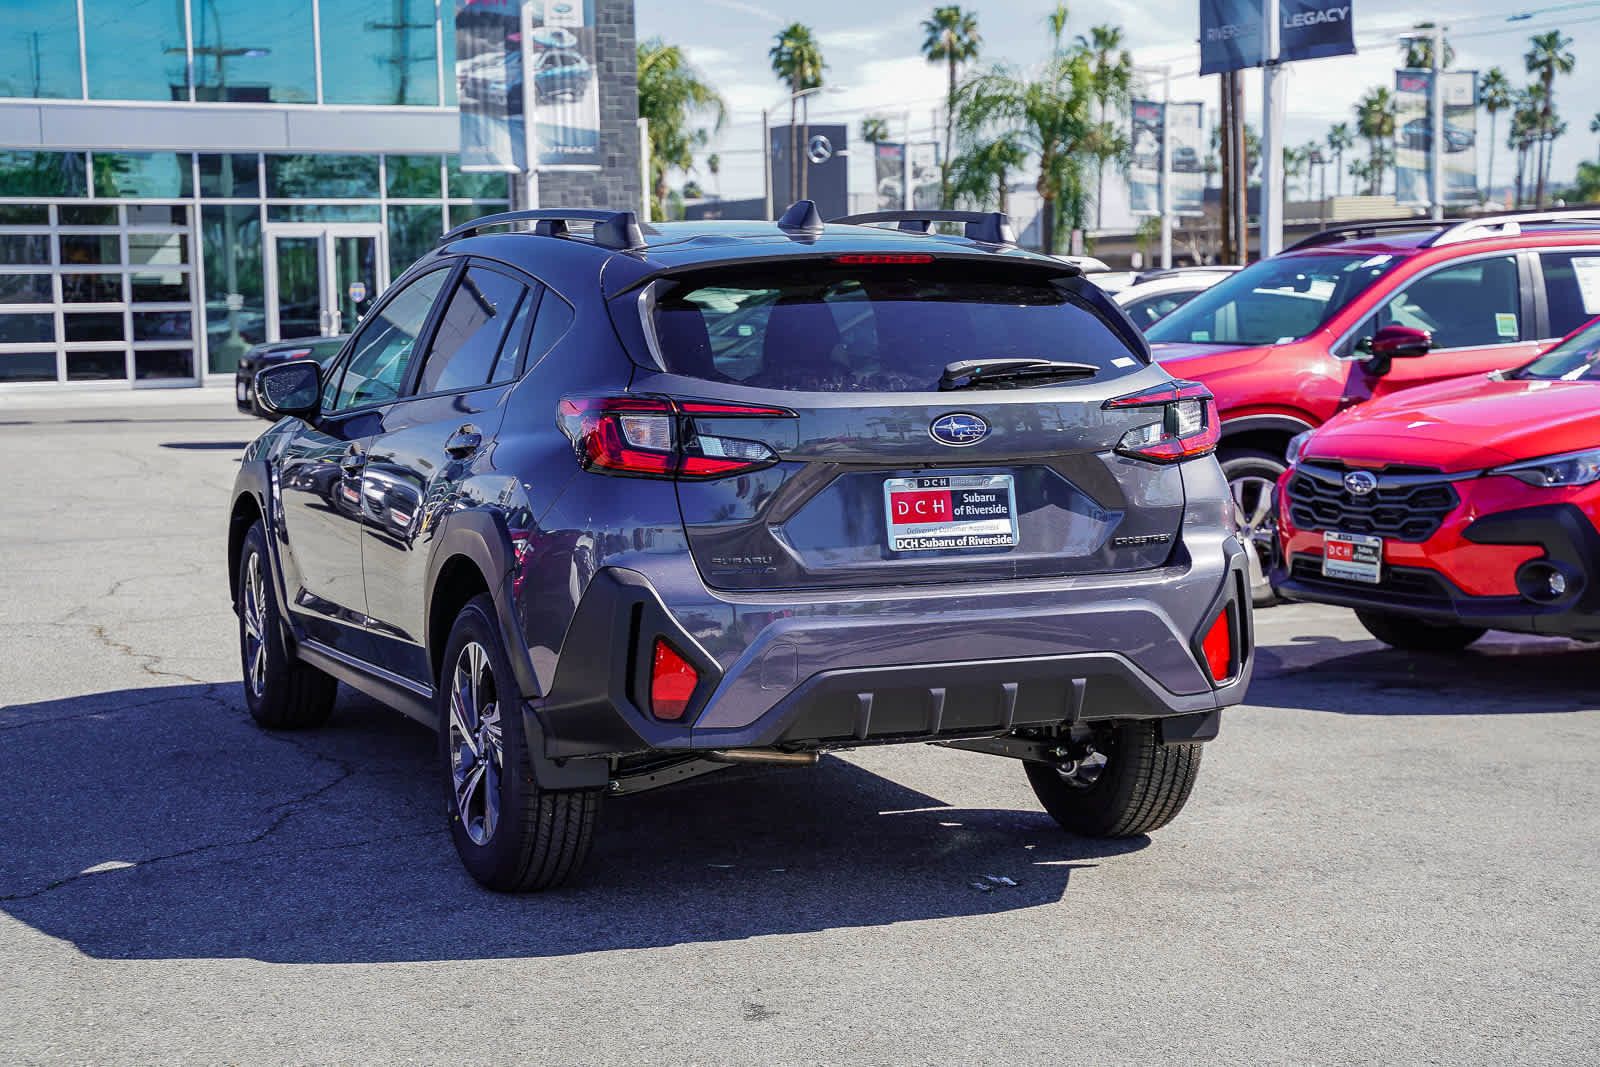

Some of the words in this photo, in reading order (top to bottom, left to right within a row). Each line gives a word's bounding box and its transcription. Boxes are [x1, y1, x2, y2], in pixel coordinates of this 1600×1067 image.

[1284, 7, 1349, 29] LEGACY
[924, 478, 947, 487] DCH
[963, 493, 996, 503] Subaru
[898, 499, 945, 515] DCH
[954, 505, 965, 516] of
[966, 503, 1008, 515] Riverside
[896, 539, 919, 549] DCH
[920, 537, 955, 548] Subaru
[956, 535, 967, 546] of
[968, 535, 1013, 546] Riverside
